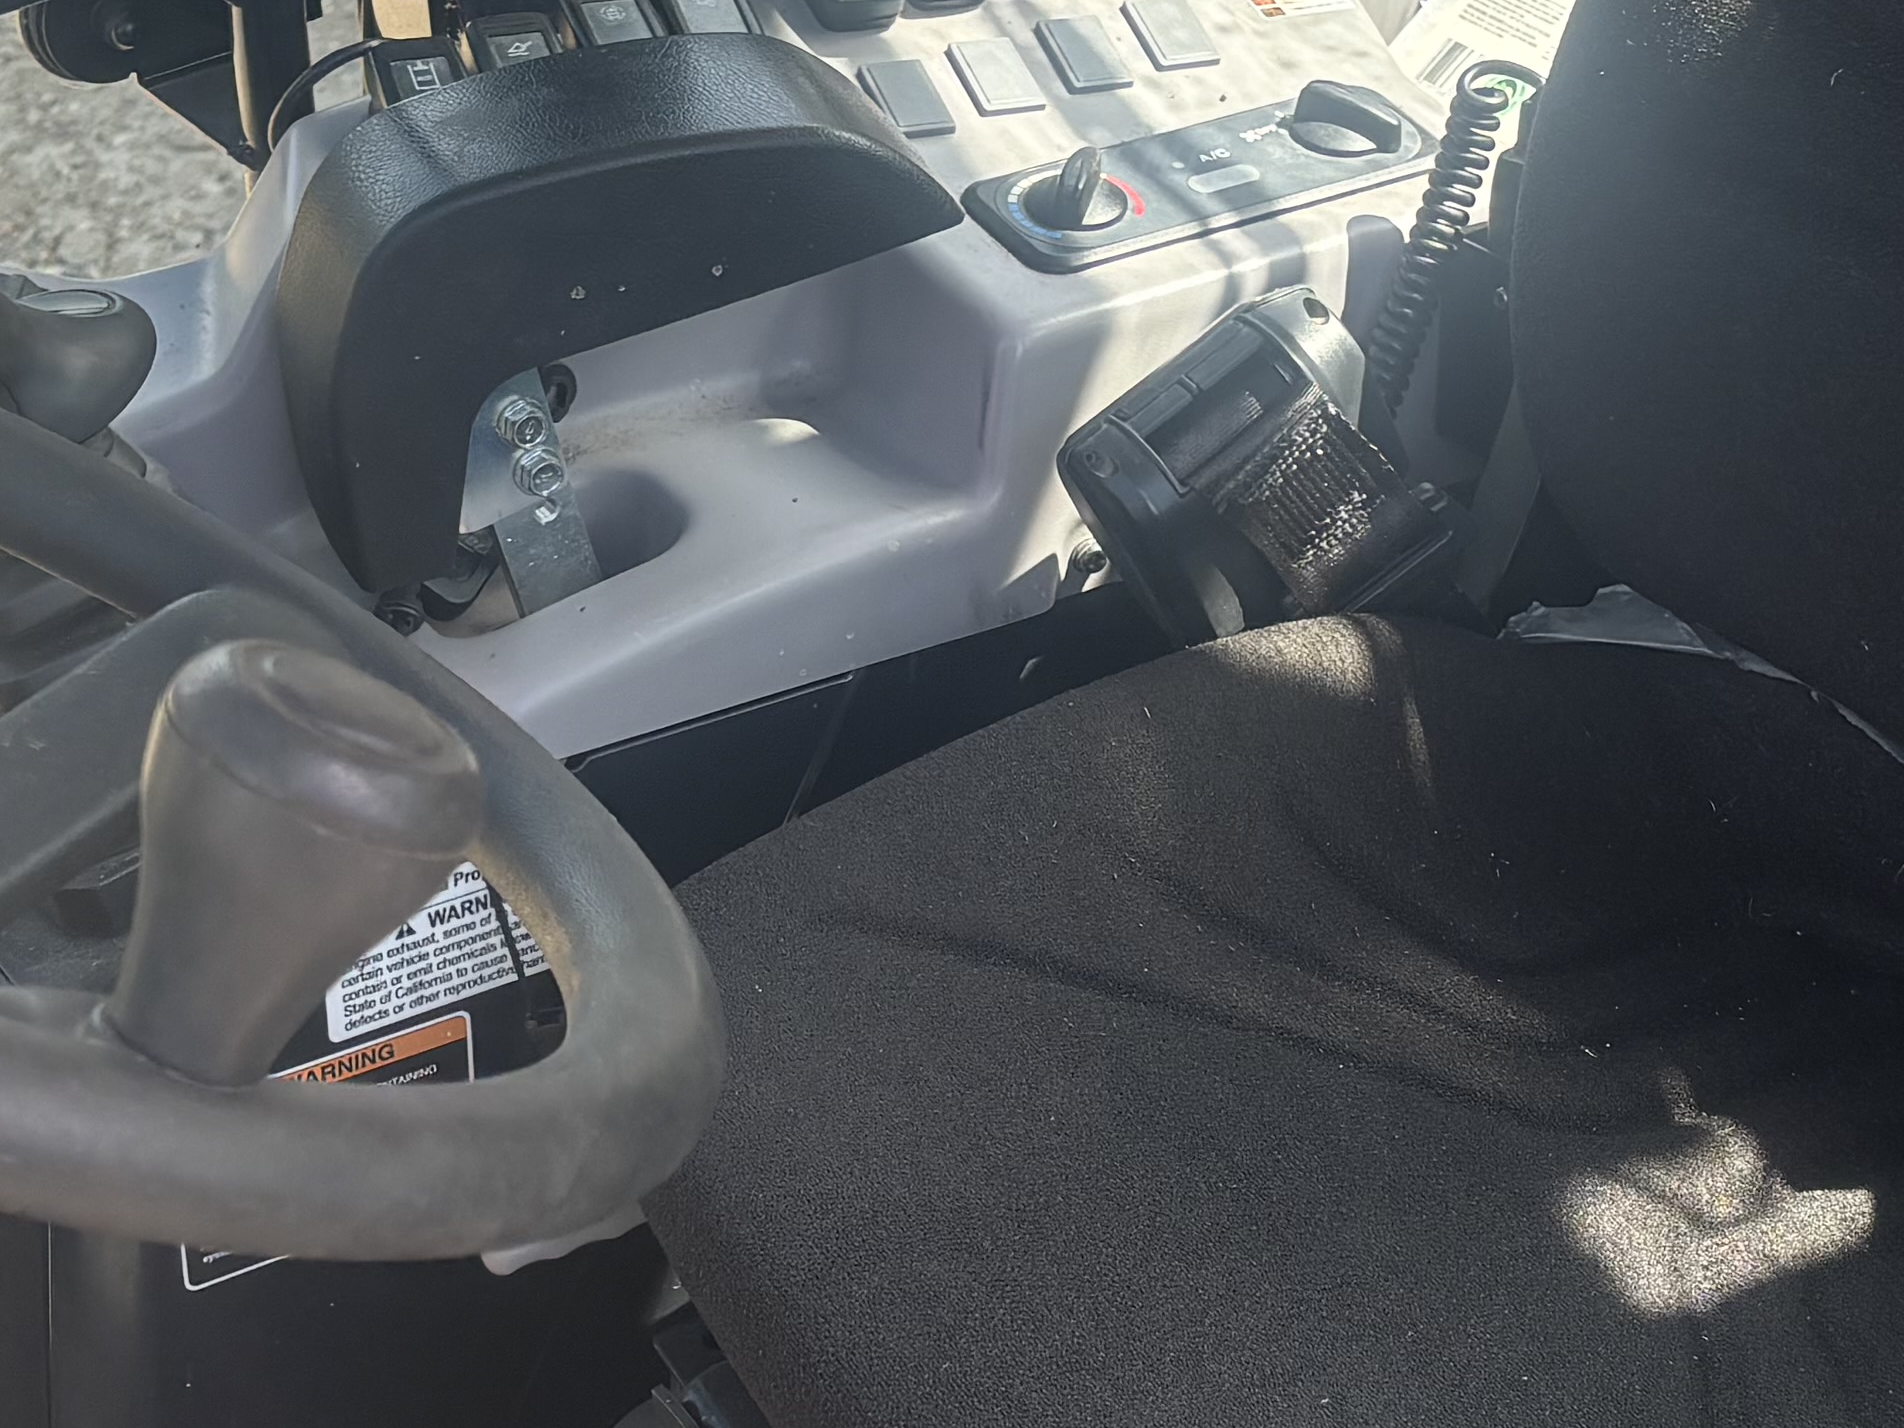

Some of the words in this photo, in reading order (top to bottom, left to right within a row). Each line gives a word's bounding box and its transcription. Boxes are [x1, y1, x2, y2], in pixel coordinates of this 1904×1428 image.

[453, 870, 481, 887] Pro
[428, 894, 488, 927] WARN
[395, 972, 452, 998] California
[295, 1044, 395, 1083] ARNING
